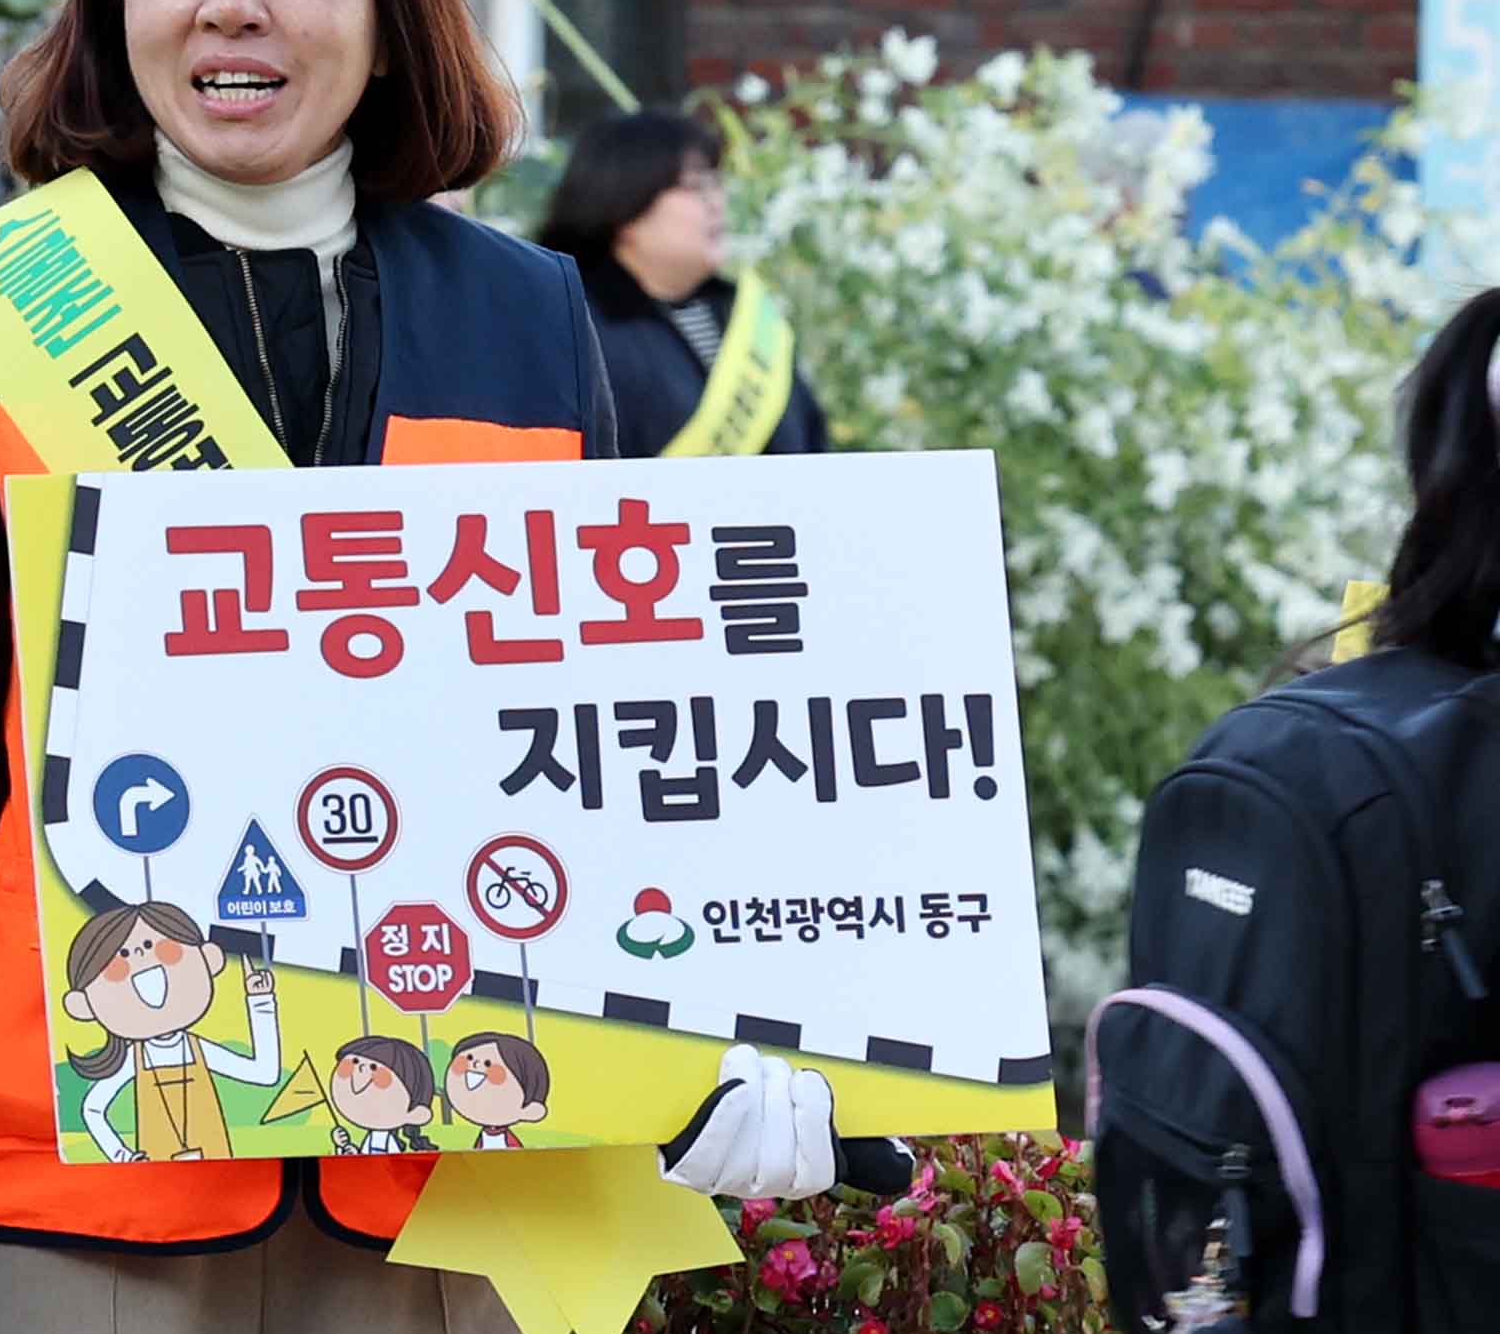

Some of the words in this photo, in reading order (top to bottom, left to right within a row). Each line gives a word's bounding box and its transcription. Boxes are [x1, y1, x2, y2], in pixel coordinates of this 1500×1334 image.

[163, 499, 809, 678] 교통신호를
[498, 694, 998, 822] 지킵시다!
[322, 793, 373, 835] 30
[227, 900, 268, 916] 어린이
[269, 899, 297, 915] 보호
[702, 895, 907, 944] 인천광역시
[919, 891, 993, 938] 동구
[388, 963, 453, 993] STOP
